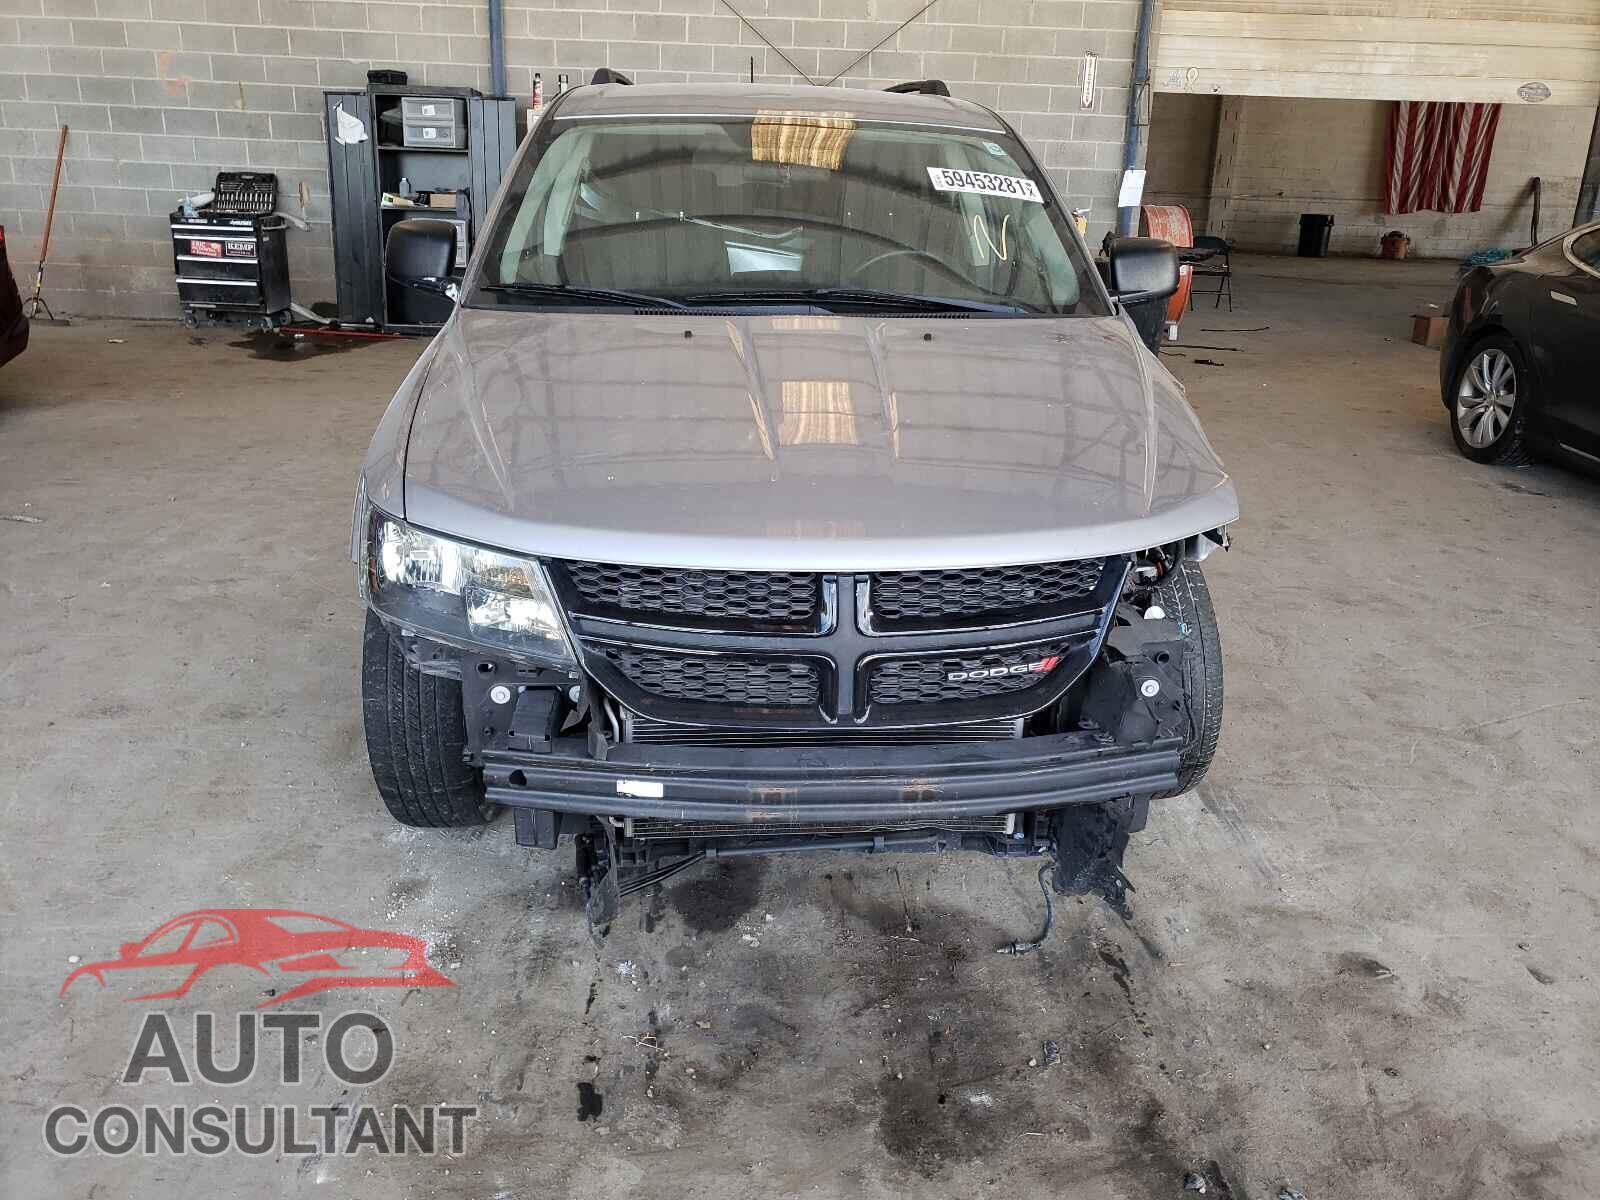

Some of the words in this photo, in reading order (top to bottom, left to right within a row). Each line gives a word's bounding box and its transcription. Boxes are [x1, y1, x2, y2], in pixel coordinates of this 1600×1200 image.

[941, 170, 1026, 196] 59453281
[227, 242, 254, 251] KEMP
[947, 662, 1046, 681] DODGE
